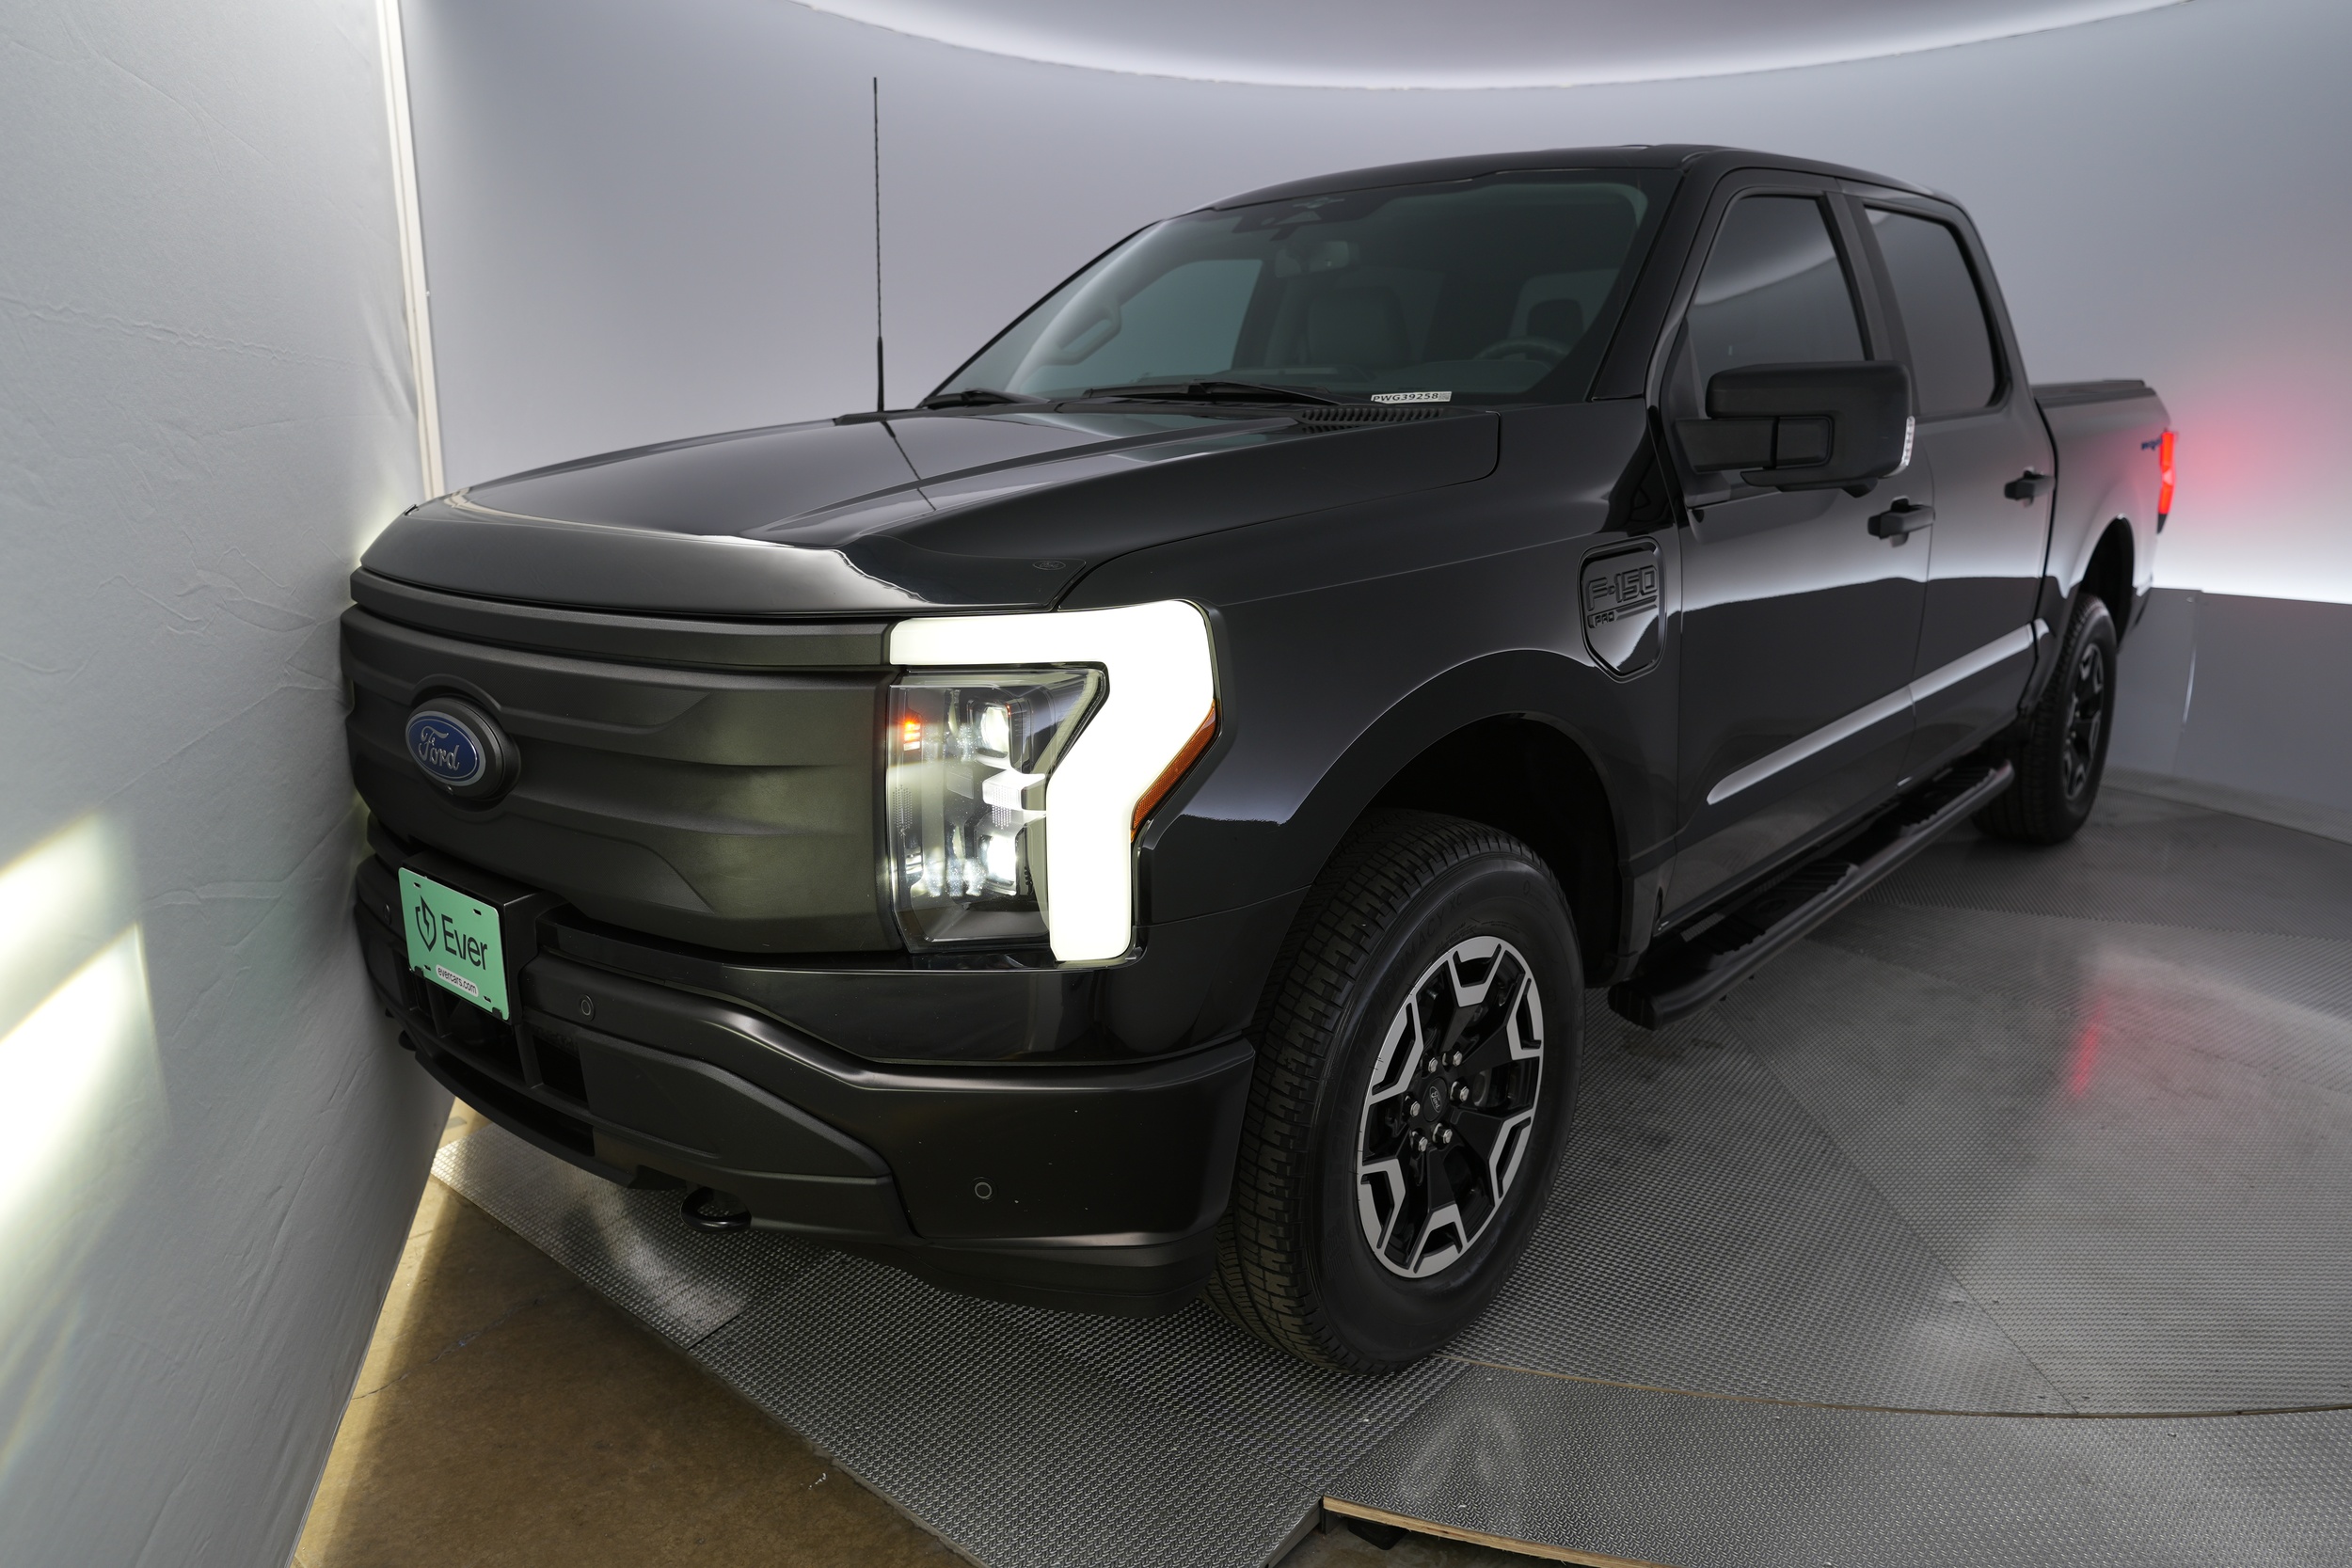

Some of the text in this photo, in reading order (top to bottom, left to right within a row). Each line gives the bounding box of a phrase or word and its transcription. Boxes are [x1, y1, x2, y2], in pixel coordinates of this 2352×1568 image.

[1373, 393, 1438, 402] PWG39258
[1587, 564, 1658, 611] F-150
[1596, 611, 1615, 626] PRO
[419, 725, 460, 771] Ford
[441, 913, 488, 971] Ever
[437, 967, 478, 995] evercars.com
